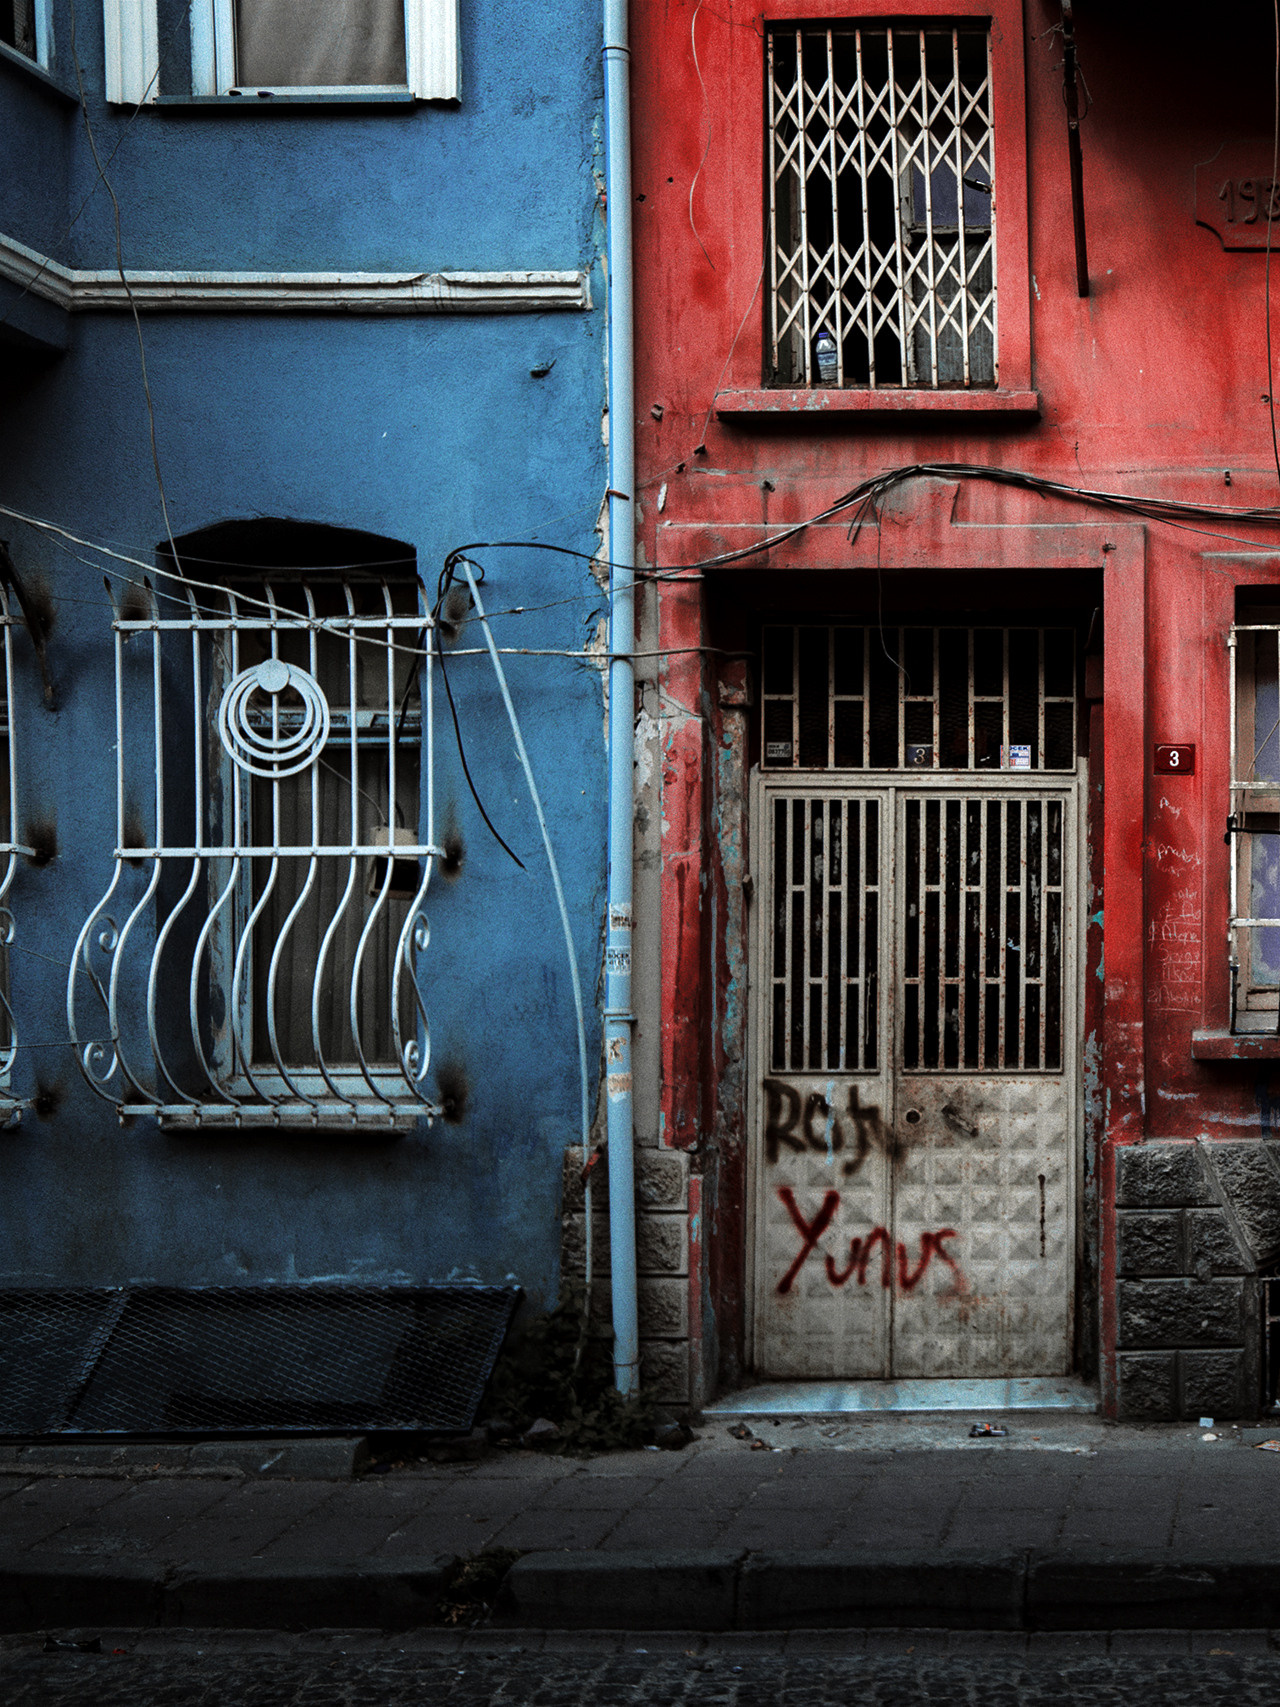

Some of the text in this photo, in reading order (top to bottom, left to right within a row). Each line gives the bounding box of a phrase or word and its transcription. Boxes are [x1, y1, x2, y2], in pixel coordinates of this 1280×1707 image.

[913, 747, 926, 765] 3
[1169, 750, 1180, 767] 3
[777, 1184, 966, 1294] Yunus
